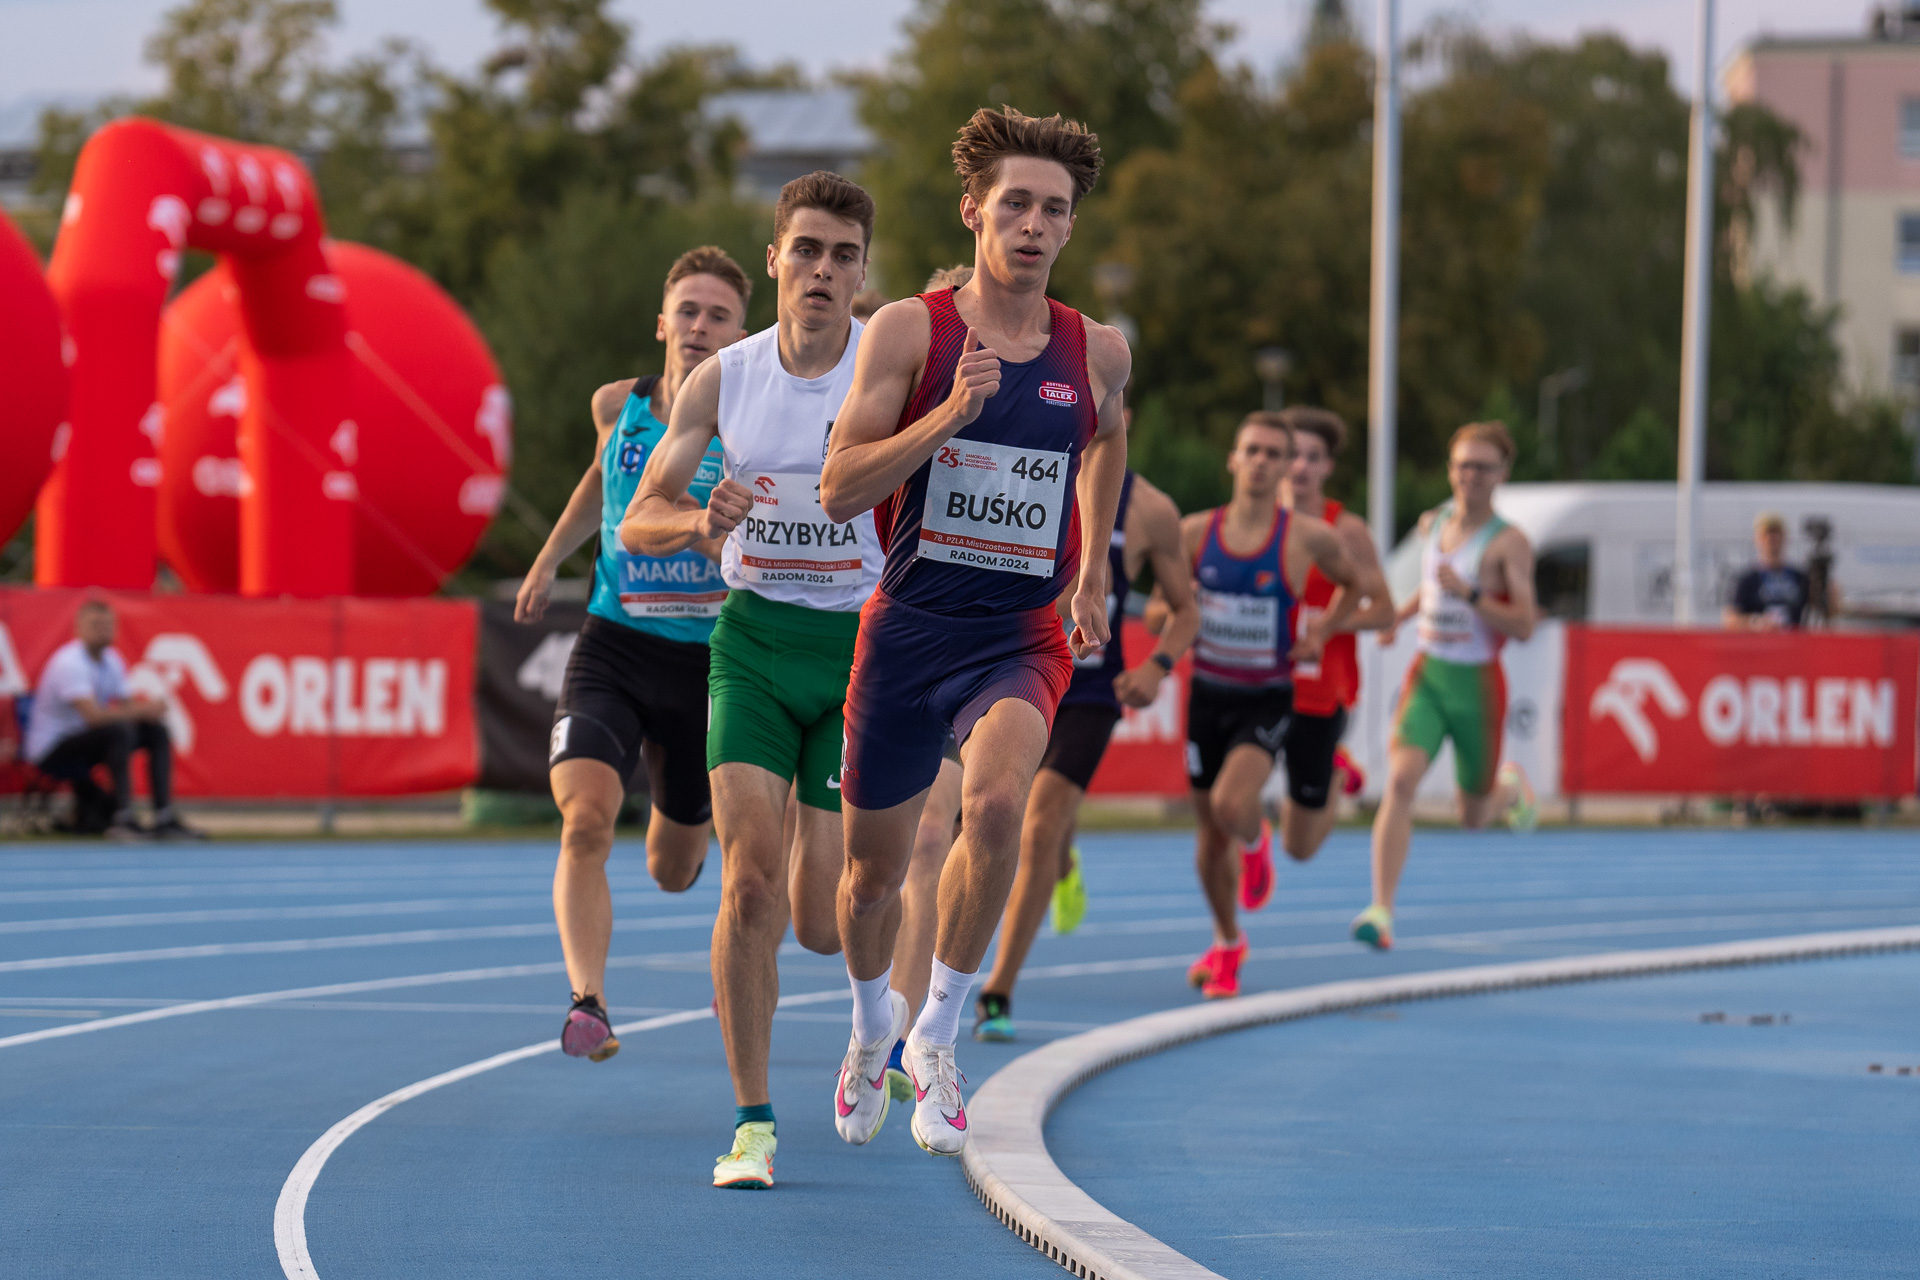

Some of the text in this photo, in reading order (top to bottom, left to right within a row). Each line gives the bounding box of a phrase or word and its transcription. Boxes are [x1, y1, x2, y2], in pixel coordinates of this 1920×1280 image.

[1043, 388, 1074, 401] TALEX
[1011, 456, 1059, 483] 464
[754, 494, 779, 506] ORLEN
[946, 491, 1047, 530] BUŚKO
[746, 516, 858, 547] PRZYBYŁA
[933, 533, 1048, 557] 78. PZLA Mistrzostwa Polski U20
[626, 560, 721, 583] MAKIŁA
[773, 560, 815, 569] Mistrzostwa
[815, 561, 836, 570] Polski
[837, 561, 851, 569] U20
[949, 549, 1030, 571] RADOM 2024
[762, 572, 833, 583] RADOM 2024
[239, 653, 445, 737] ORLEN
[1699, 674, 1896, 748] ORLEN
